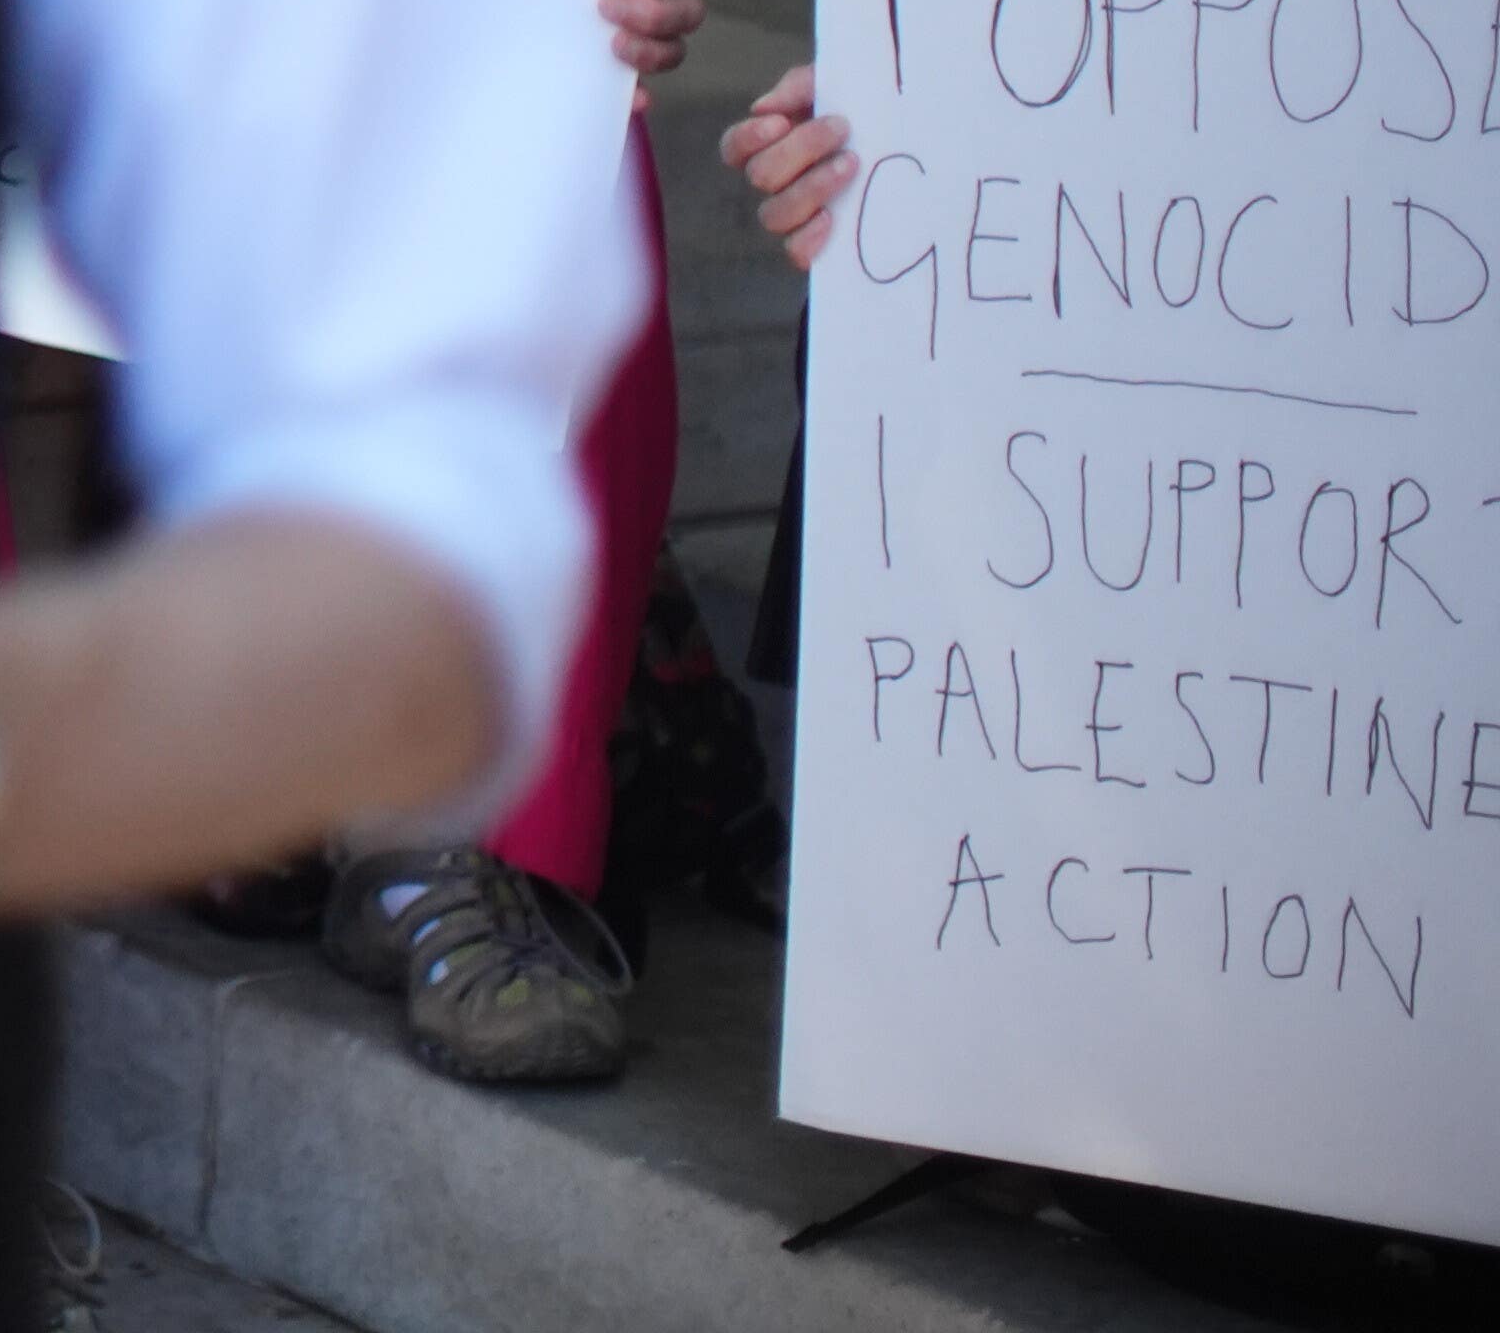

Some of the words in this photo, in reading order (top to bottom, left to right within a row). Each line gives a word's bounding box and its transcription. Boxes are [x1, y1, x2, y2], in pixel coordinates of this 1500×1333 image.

[858, 153, 1489, 360] GENOCID
[988, 430, 1500, 630] SUPPOR
[864, 636, 1500, 831] PALESTINE
[938, 835, 1422, 1019] ACTION
